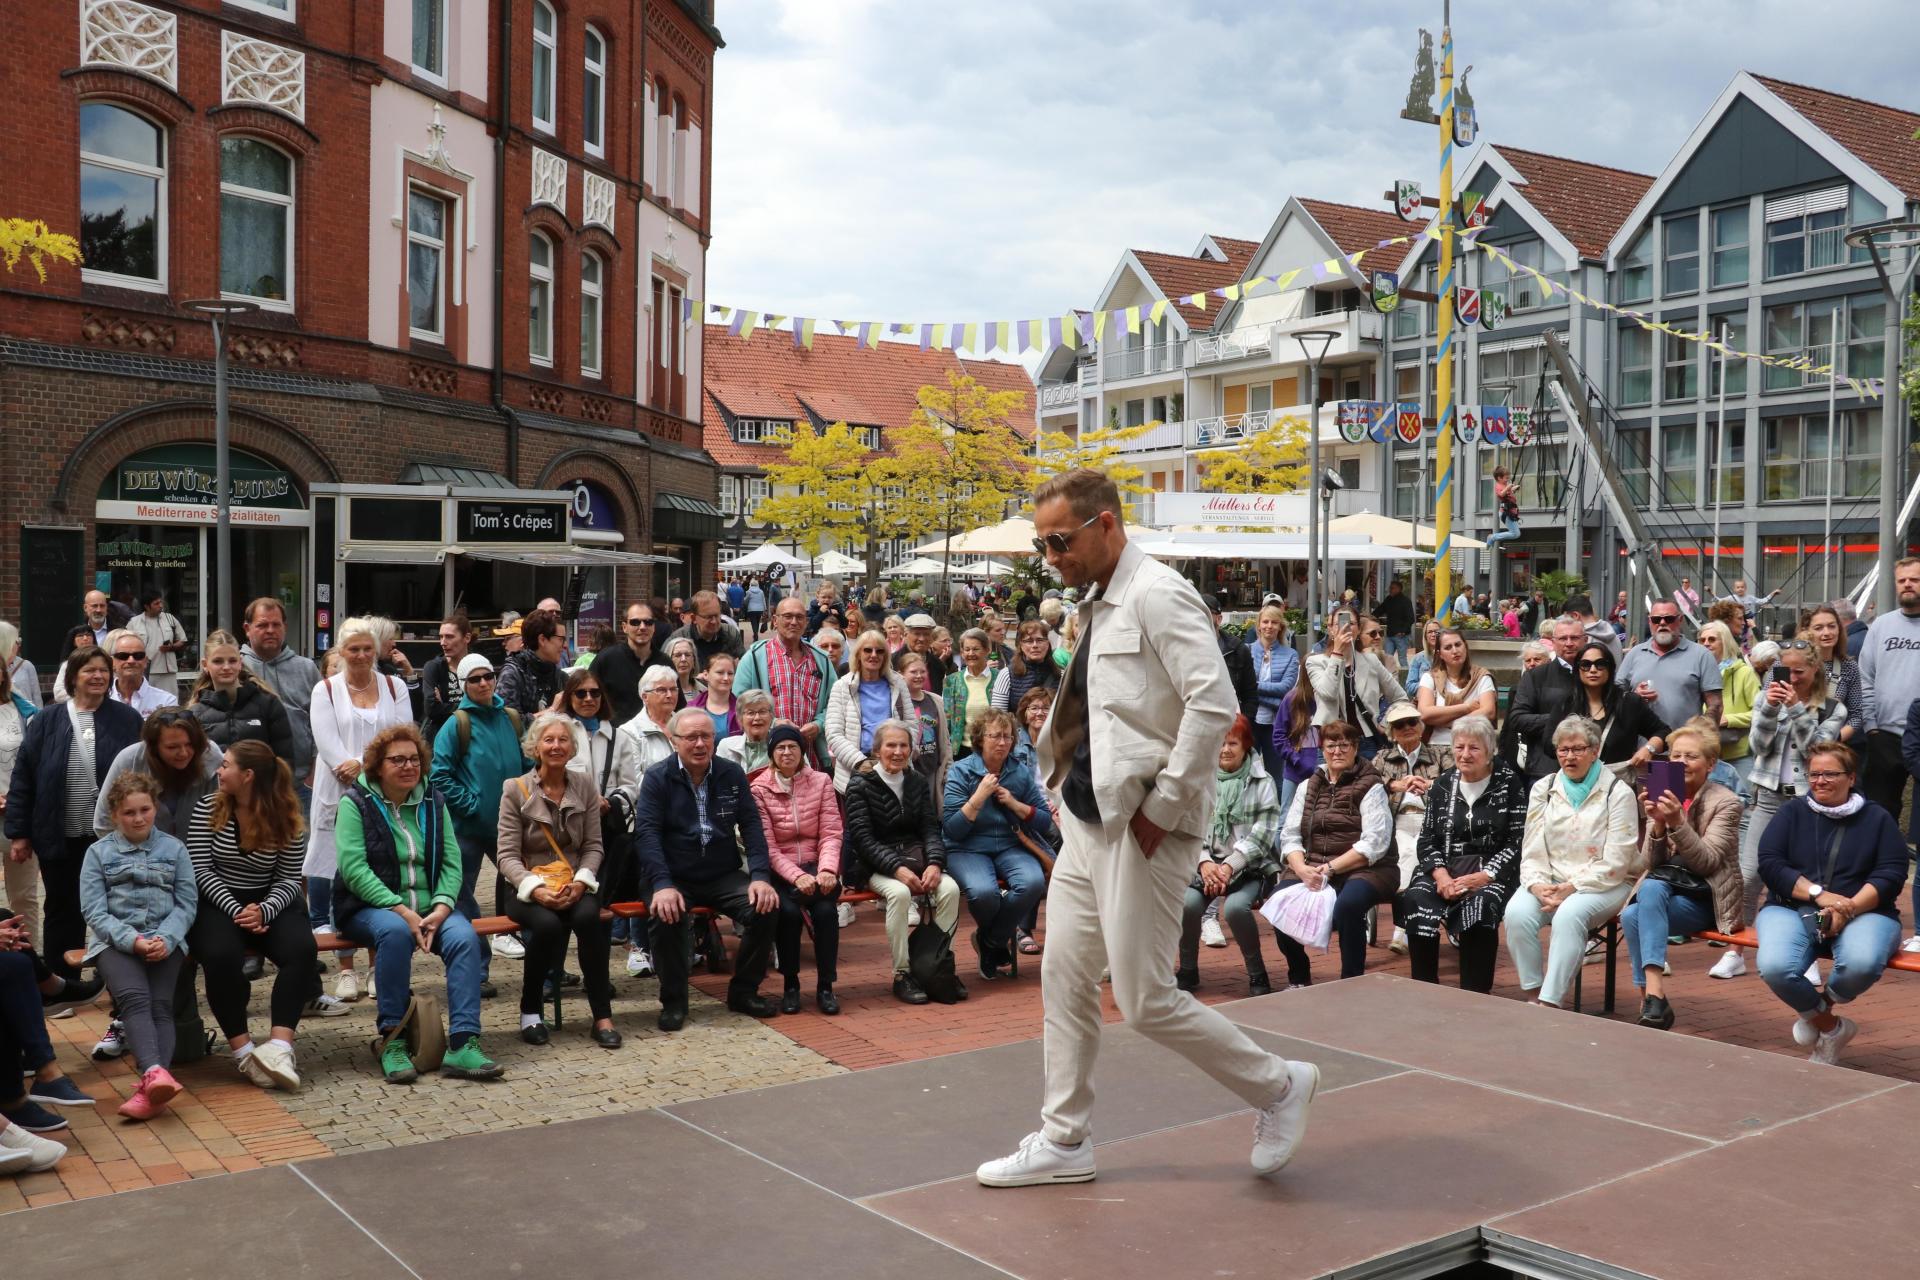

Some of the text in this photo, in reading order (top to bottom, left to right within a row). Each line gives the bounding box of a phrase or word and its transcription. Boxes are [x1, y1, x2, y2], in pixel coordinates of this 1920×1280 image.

[124, 470, 160, 490] DIE
[164, 494, 242, 506] schenken & gßen
[1202, 496, 1275, 512] Müllers Eck
[137, 505, 281, 522] Mediterrane Szialitäten
[512, 514, 553, 532] Crêpes
[107, 559, 186, 569] schenken & genießen
